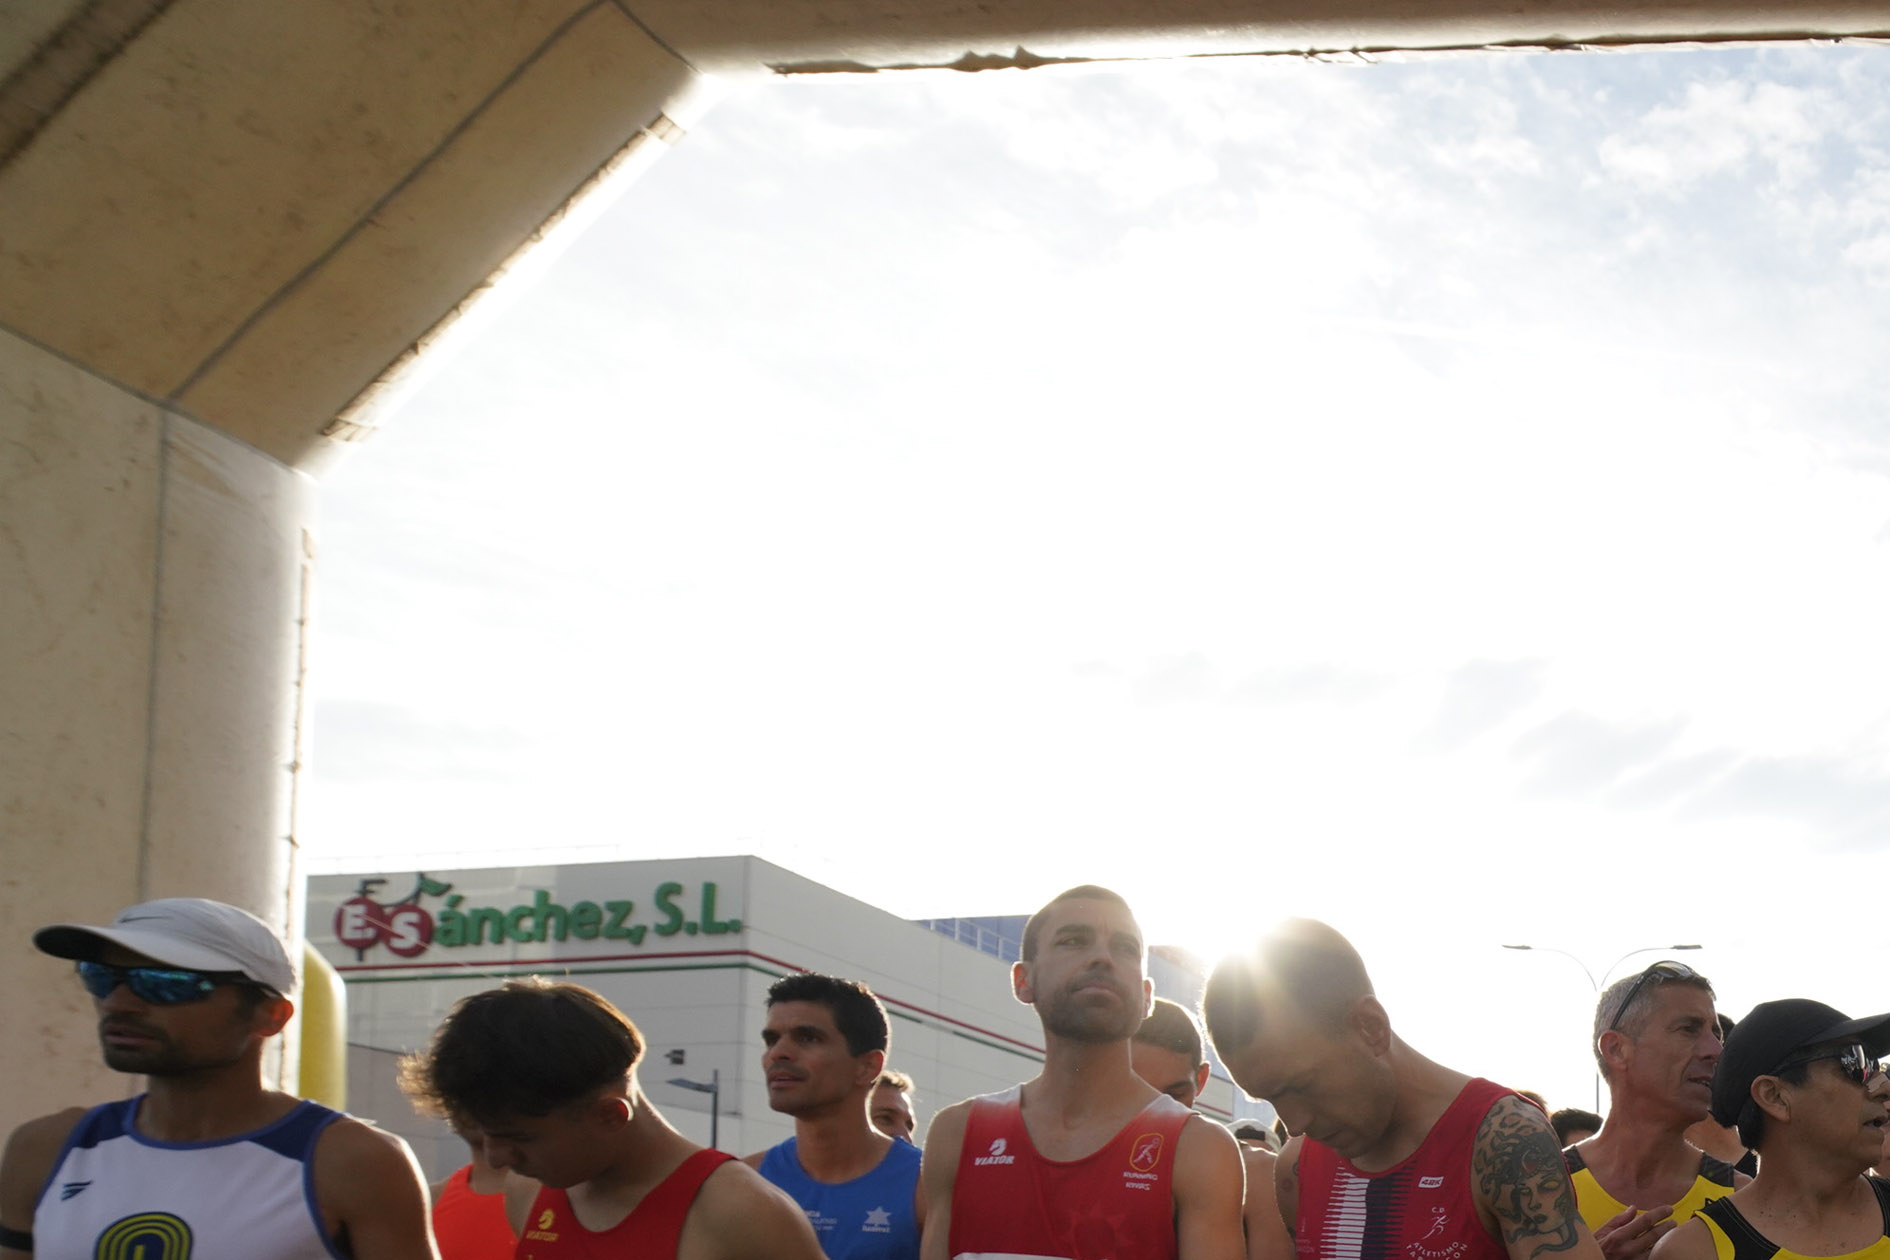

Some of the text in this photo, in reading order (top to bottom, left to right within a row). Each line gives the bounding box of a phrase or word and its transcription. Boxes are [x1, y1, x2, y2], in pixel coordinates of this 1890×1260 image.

[653, 880, 742, 936] S.L.
[974, 1155, 1016, 1166] VIATOR
[1412, 1241, 1459, 1258] ATLETISMO
